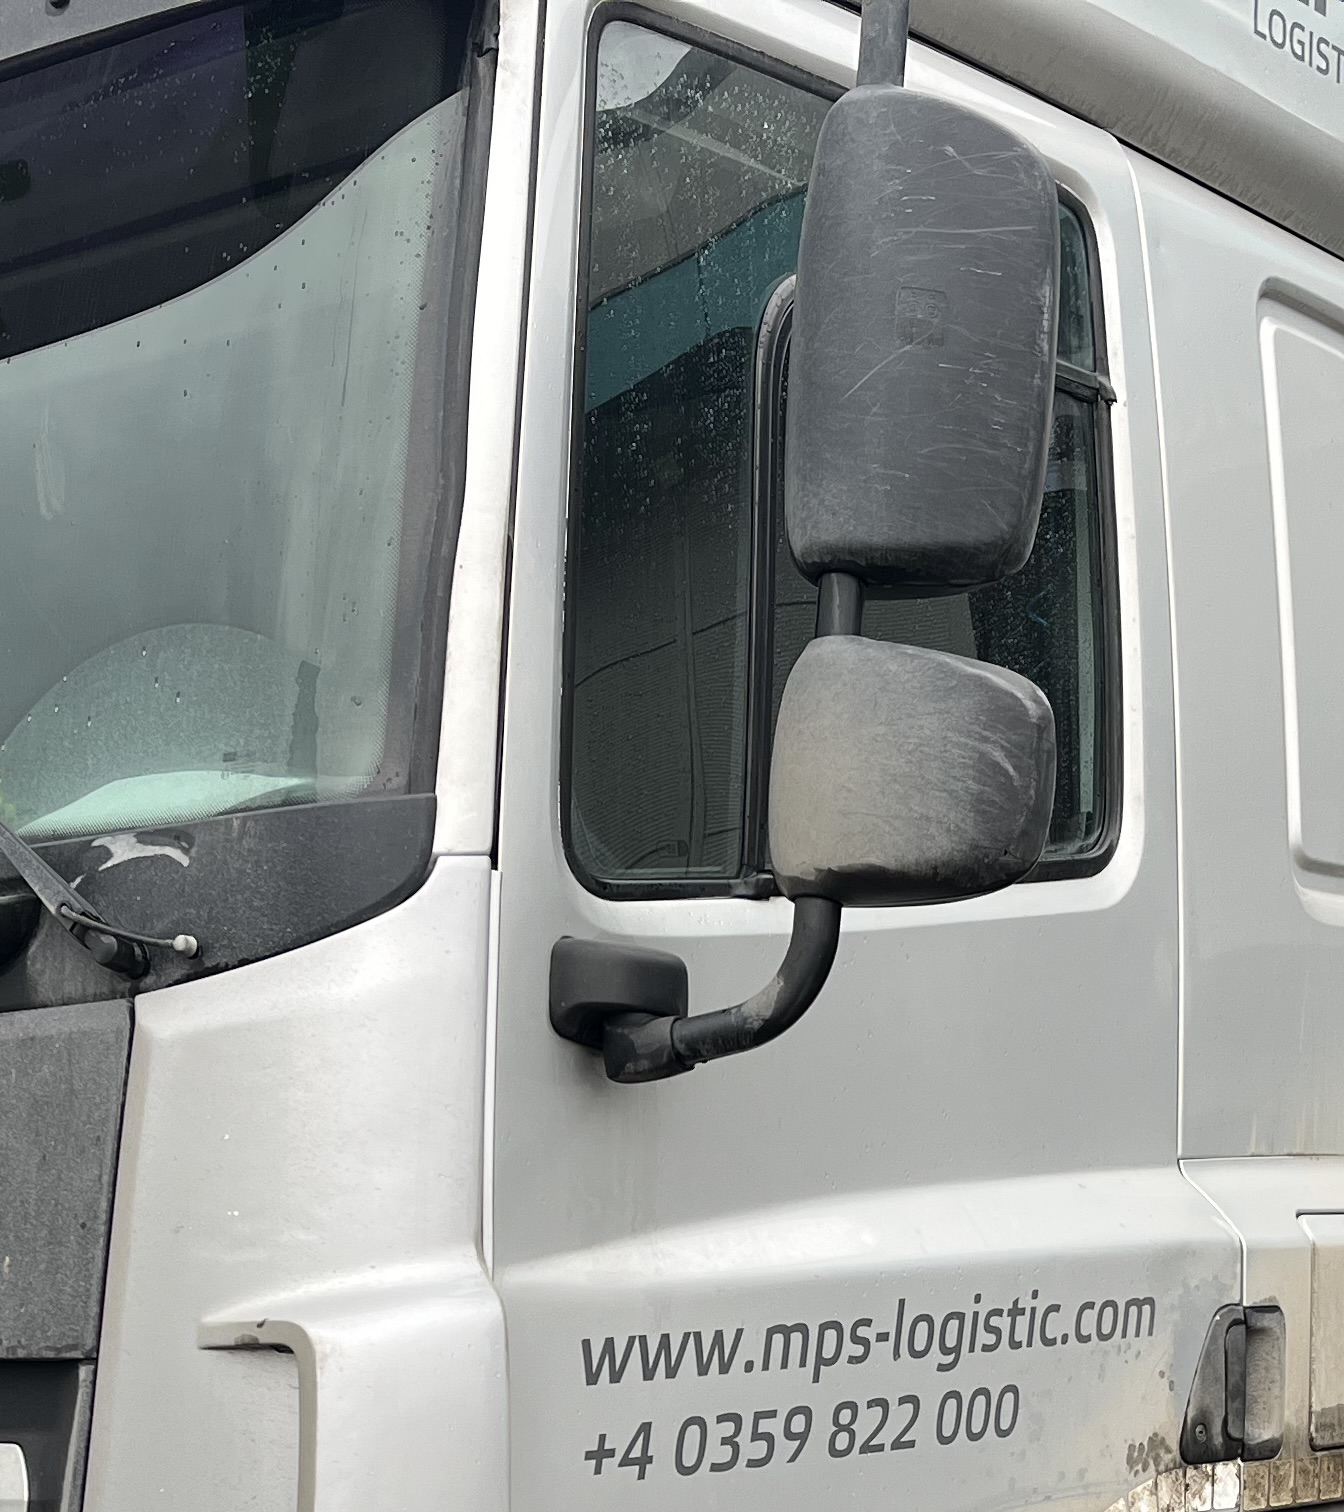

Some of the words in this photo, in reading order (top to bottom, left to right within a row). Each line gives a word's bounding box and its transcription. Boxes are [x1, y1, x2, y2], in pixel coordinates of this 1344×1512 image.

[581, 1289, 1156, 1385] www.mps-logistic.com
[584, 1421, 654, 1480] +4
[674, 1405, 813, 1476] 0359
[828, 1394, 921, 1459] 822
[936, 1384, 1020, 1446] 000
